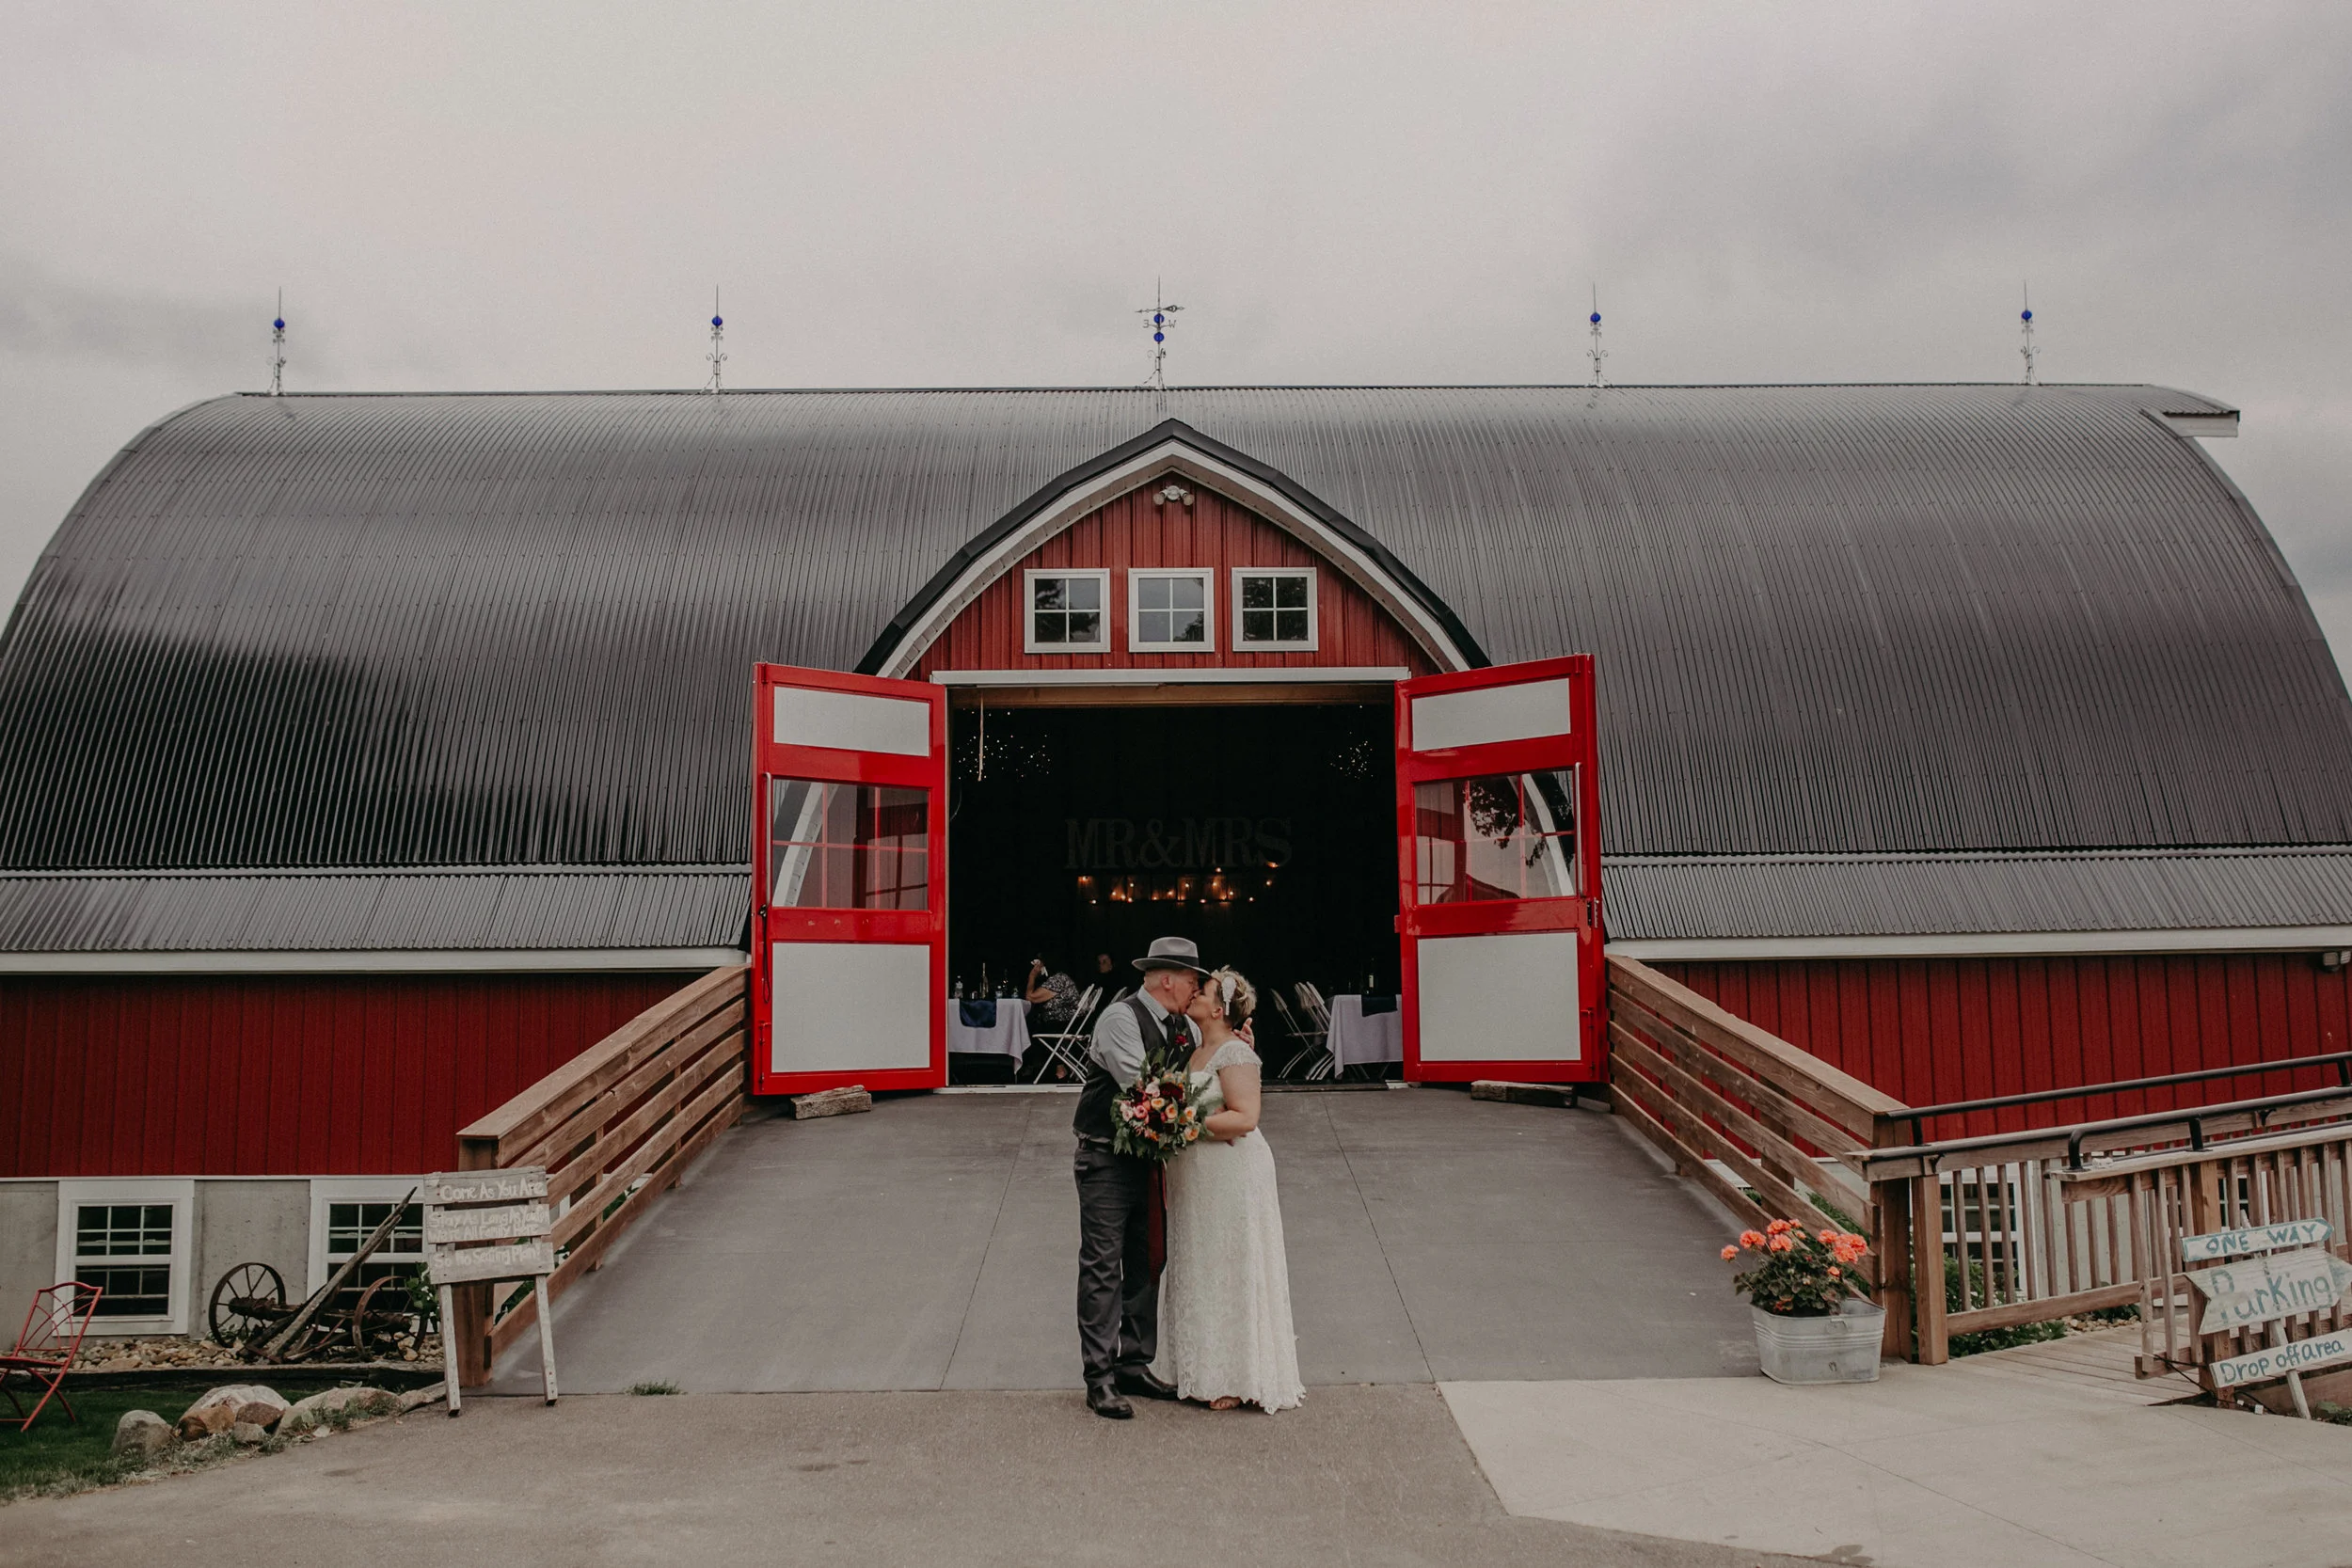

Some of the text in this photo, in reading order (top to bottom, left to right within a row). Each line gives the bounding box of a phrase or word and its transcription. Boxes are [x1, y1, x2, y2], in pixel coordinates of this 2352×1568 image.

[440, 1177, 544, 1201] Come As You Are
[429, 1212, 462, 1229] Stay
[2205, 1224, 2317, 1254] ONE WAY
[2219, 1357, 2270, 1384] Drop
